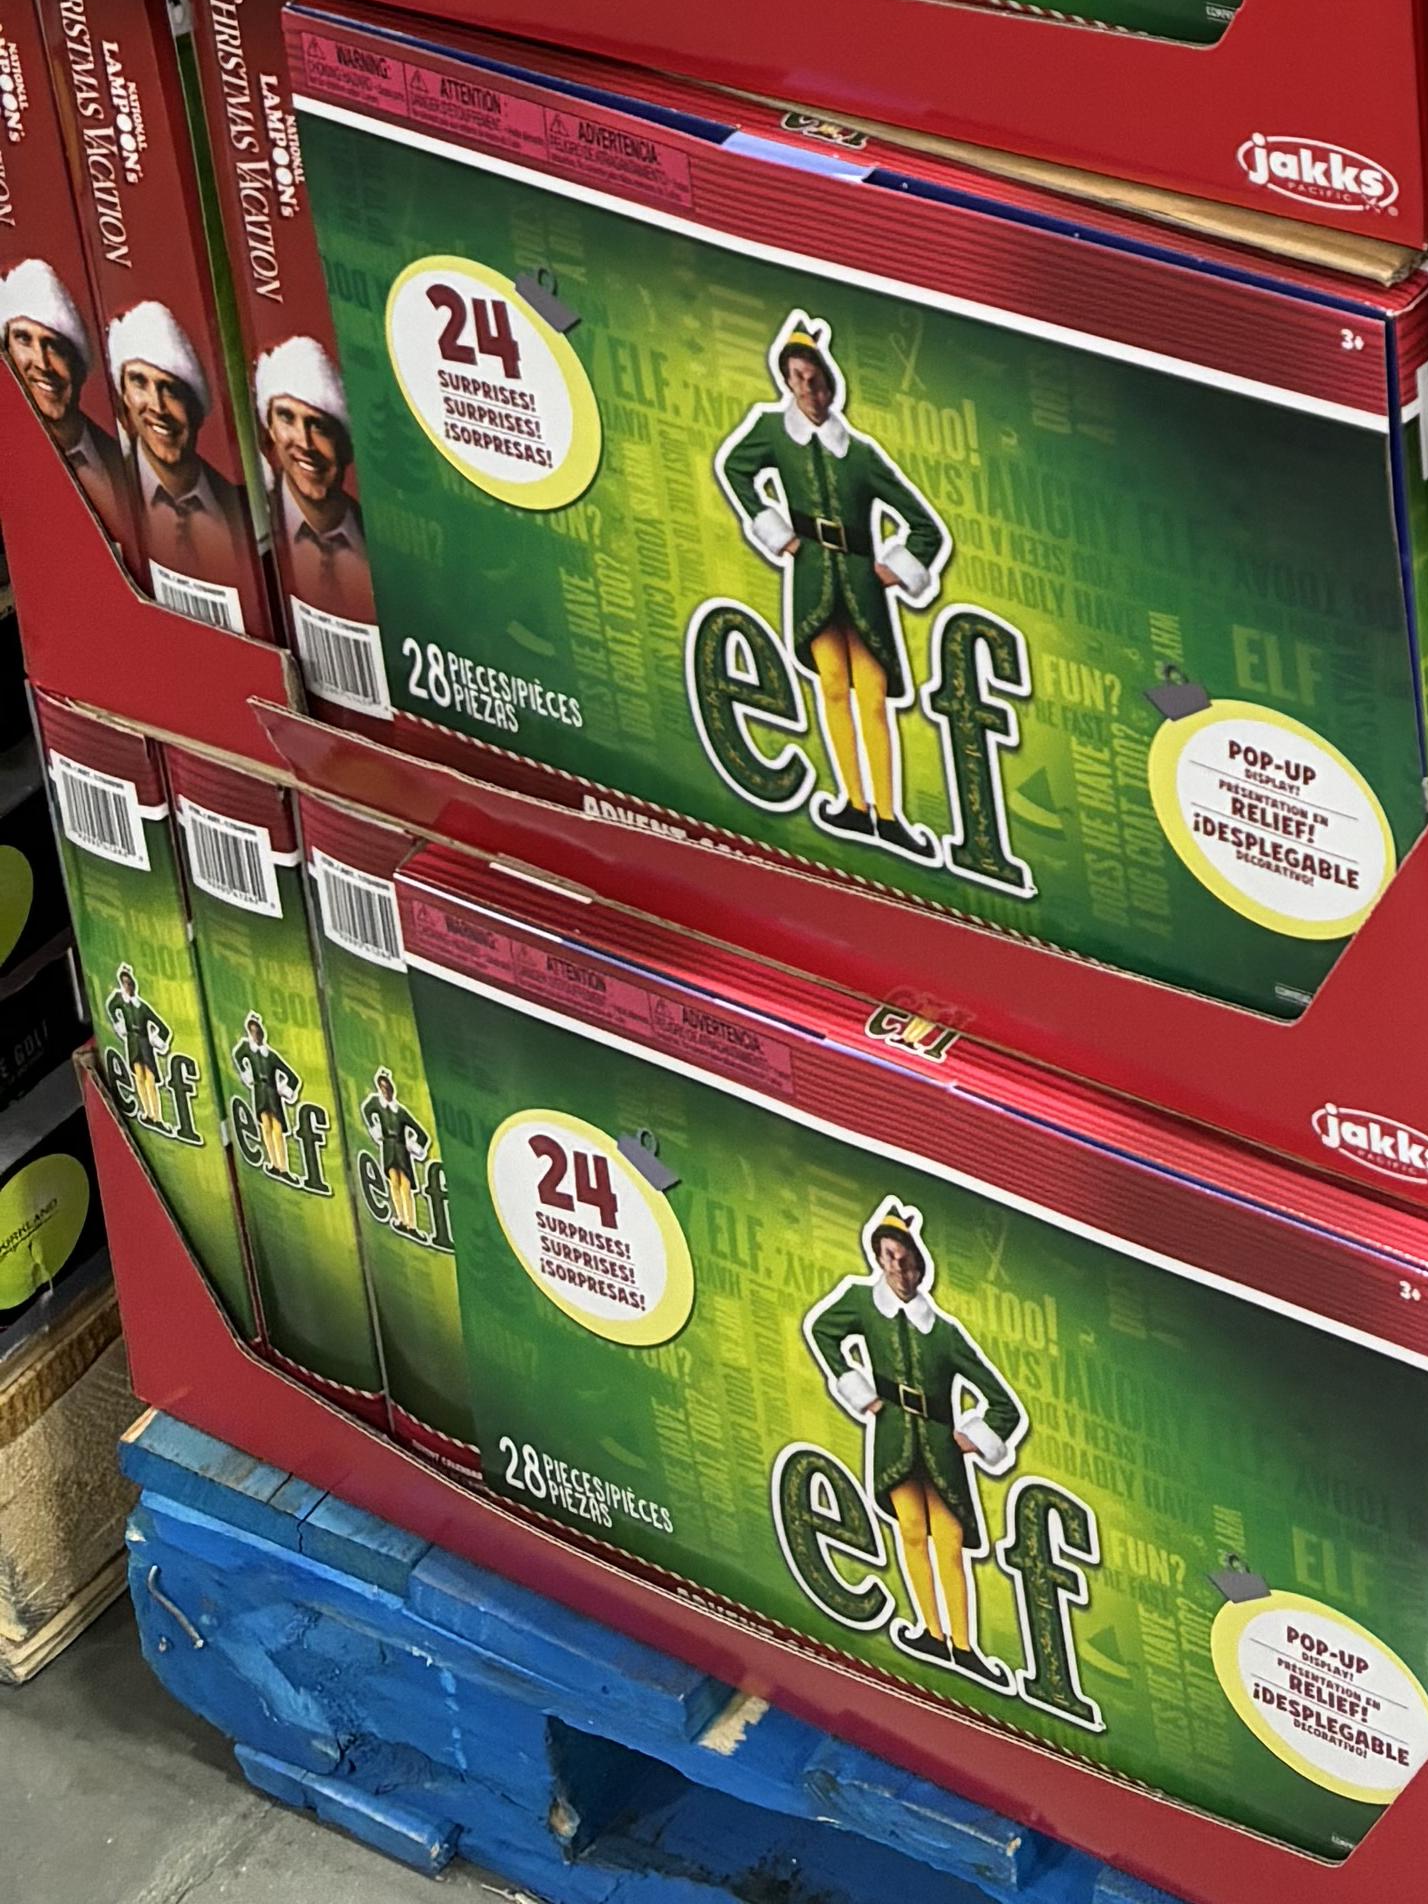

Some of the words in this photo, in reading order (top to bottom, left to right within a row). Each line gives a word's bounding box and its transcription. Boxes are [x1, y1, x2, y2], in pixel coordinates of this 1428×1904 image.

[285, 113, 305, 184] NATIONAL
[236, 159, 284, 304] VACATION
[528, 1133, 619, 1230] 24
